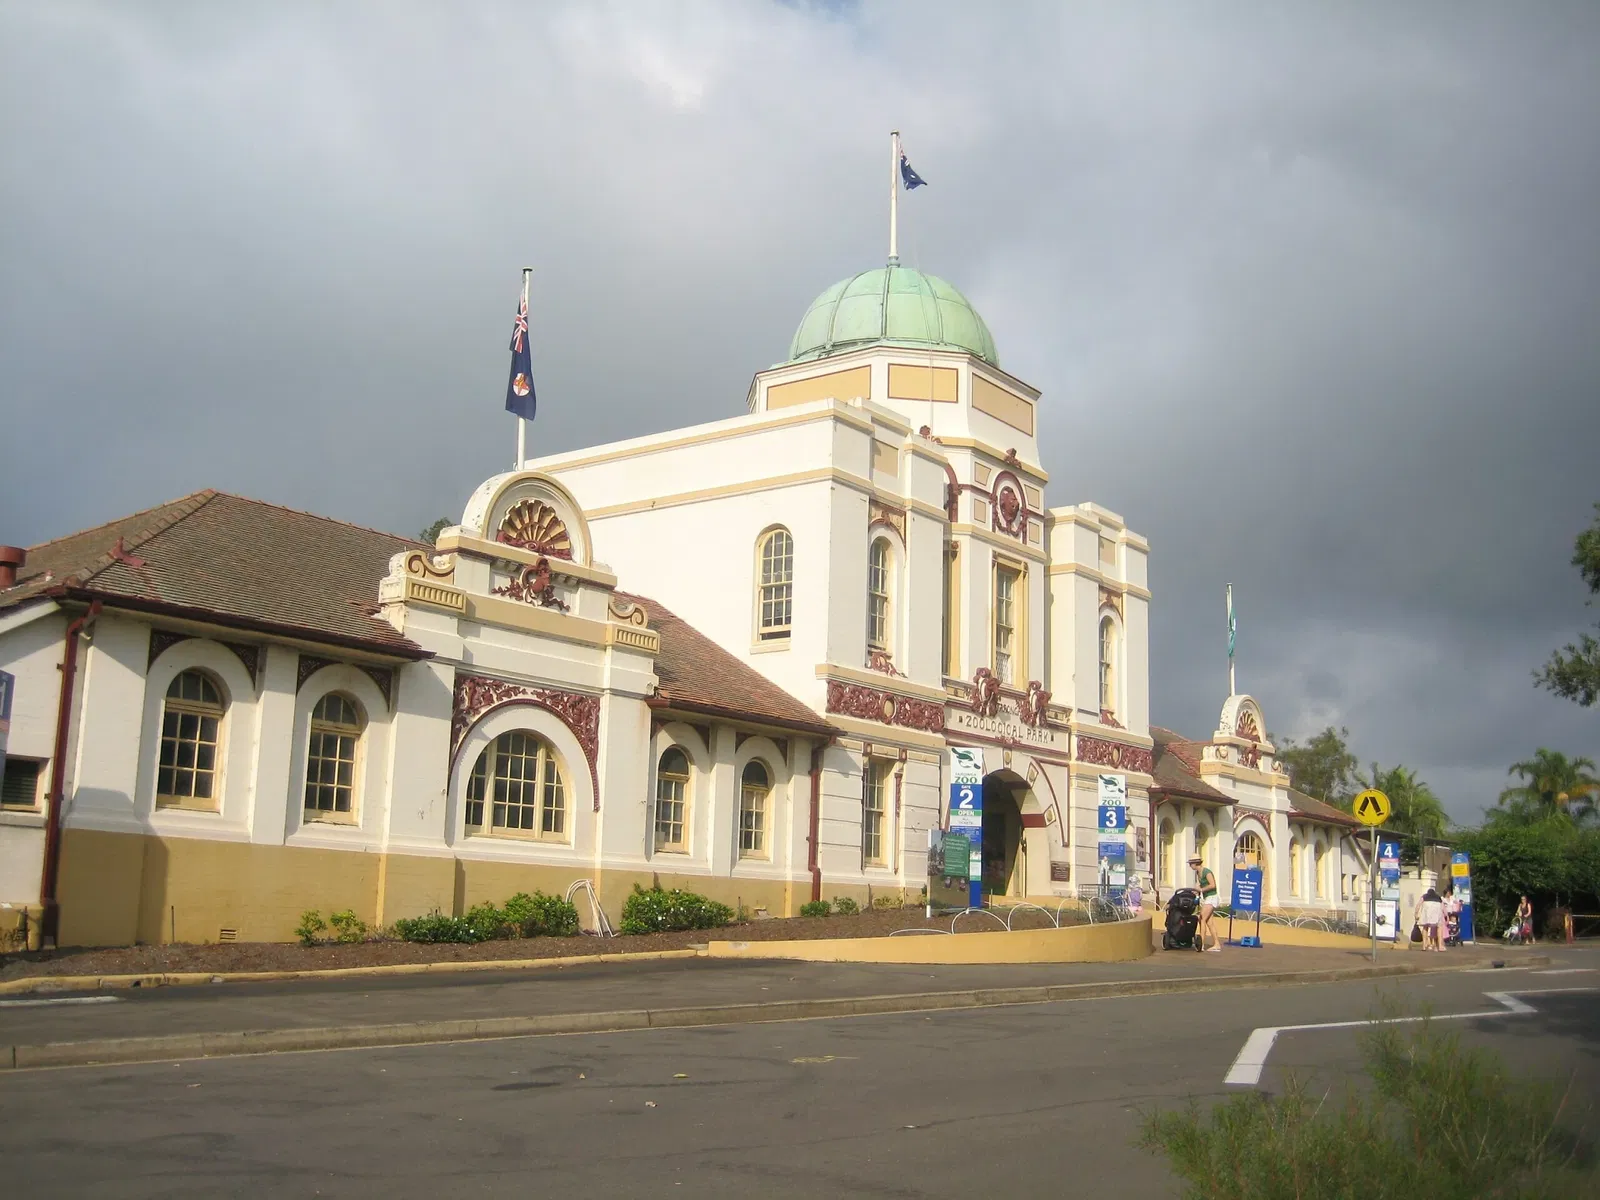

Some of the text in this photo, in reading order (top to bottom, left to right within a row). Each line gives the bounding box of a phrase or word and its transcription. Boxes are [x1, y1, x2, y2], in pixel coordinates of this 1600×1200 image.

[965, 714, 1049, 744] ZOOLOGICAL PARK
[955, 776, 978, 784] ZOO
[959, 790, 974, 809] 2
[1106, 811, 1117, 827] 3
[1384, 846, 1393, 857] 4
